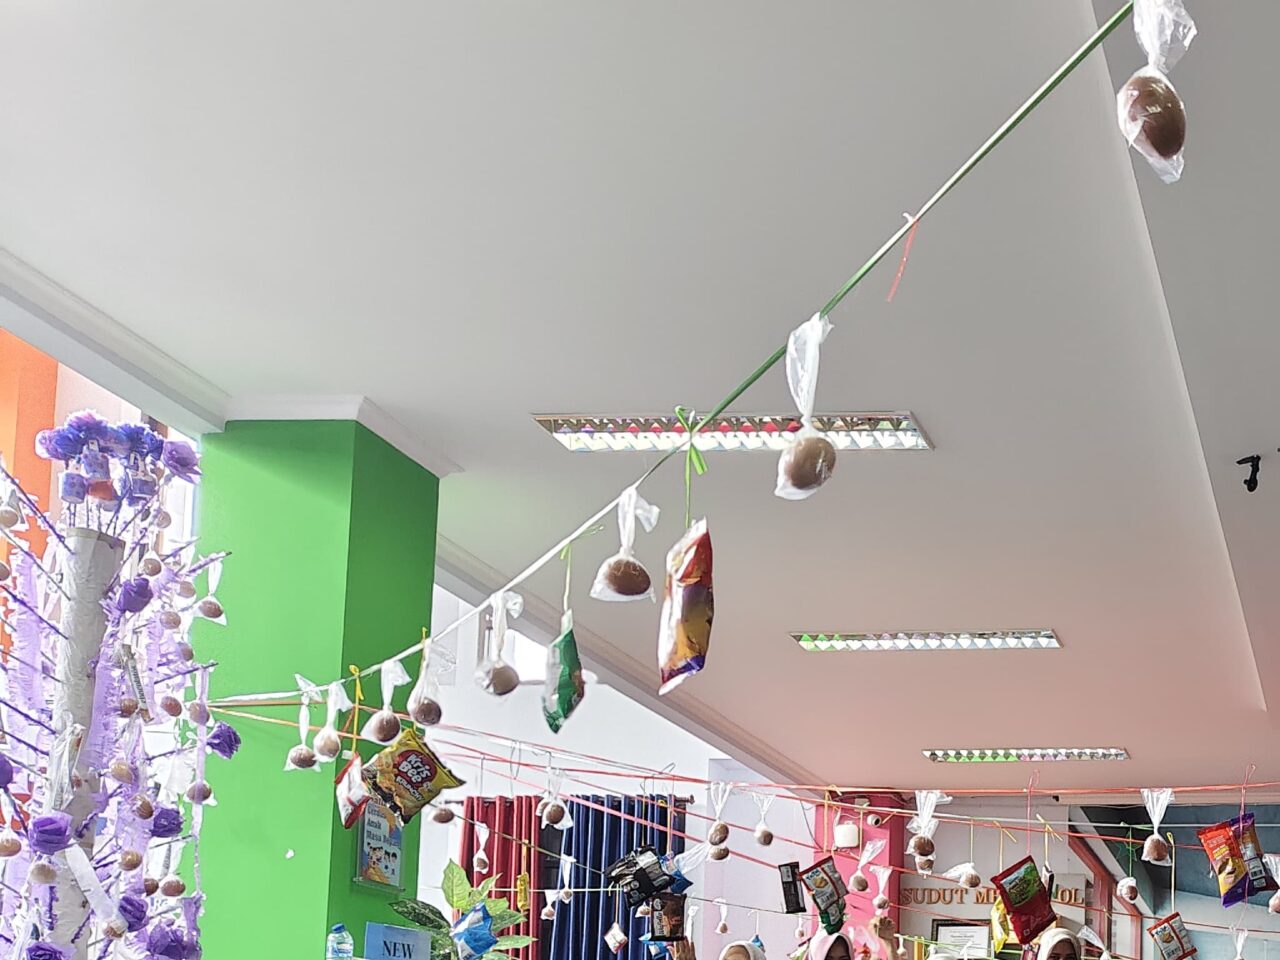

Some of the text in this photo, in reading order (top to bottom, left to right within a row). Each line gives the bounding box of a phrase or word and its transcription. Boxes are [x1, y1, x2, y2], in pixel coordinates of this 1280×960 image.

[399, 759, 422, 784] Bee
[406, 753, 432, 782] Kris
[900, 888, 967, 905] SUDUT
[382, 940, 415, 959] NEW
